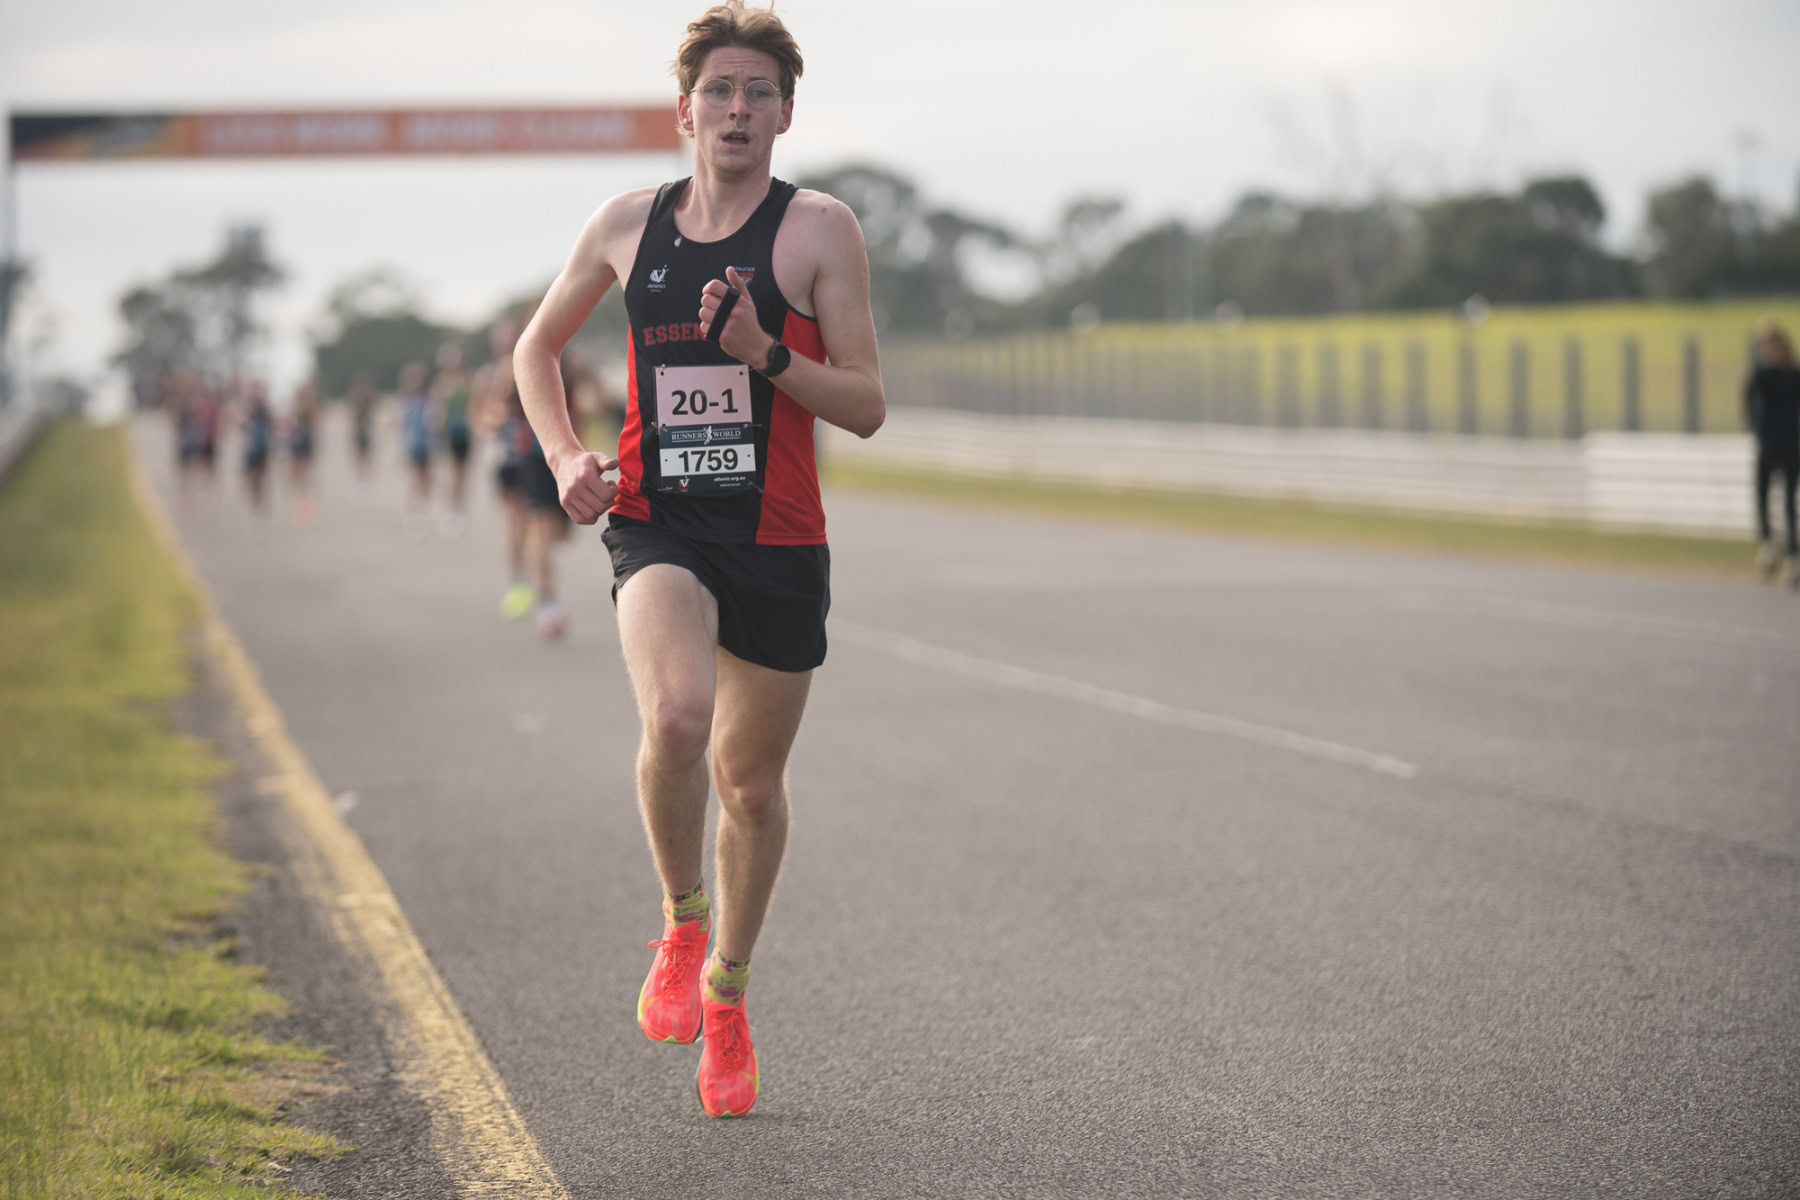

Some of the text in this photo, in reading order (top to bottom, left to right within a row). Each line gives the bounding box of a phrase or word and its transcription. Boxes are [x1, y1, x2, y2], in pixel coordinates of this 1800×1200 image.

[643, 322, 707, 346] ESSEN
[671, 388, 739, 416] 20-1
[671, 429, 742, 441] RUNNERS WORLD
[678, 447, 739, 473] 1759
